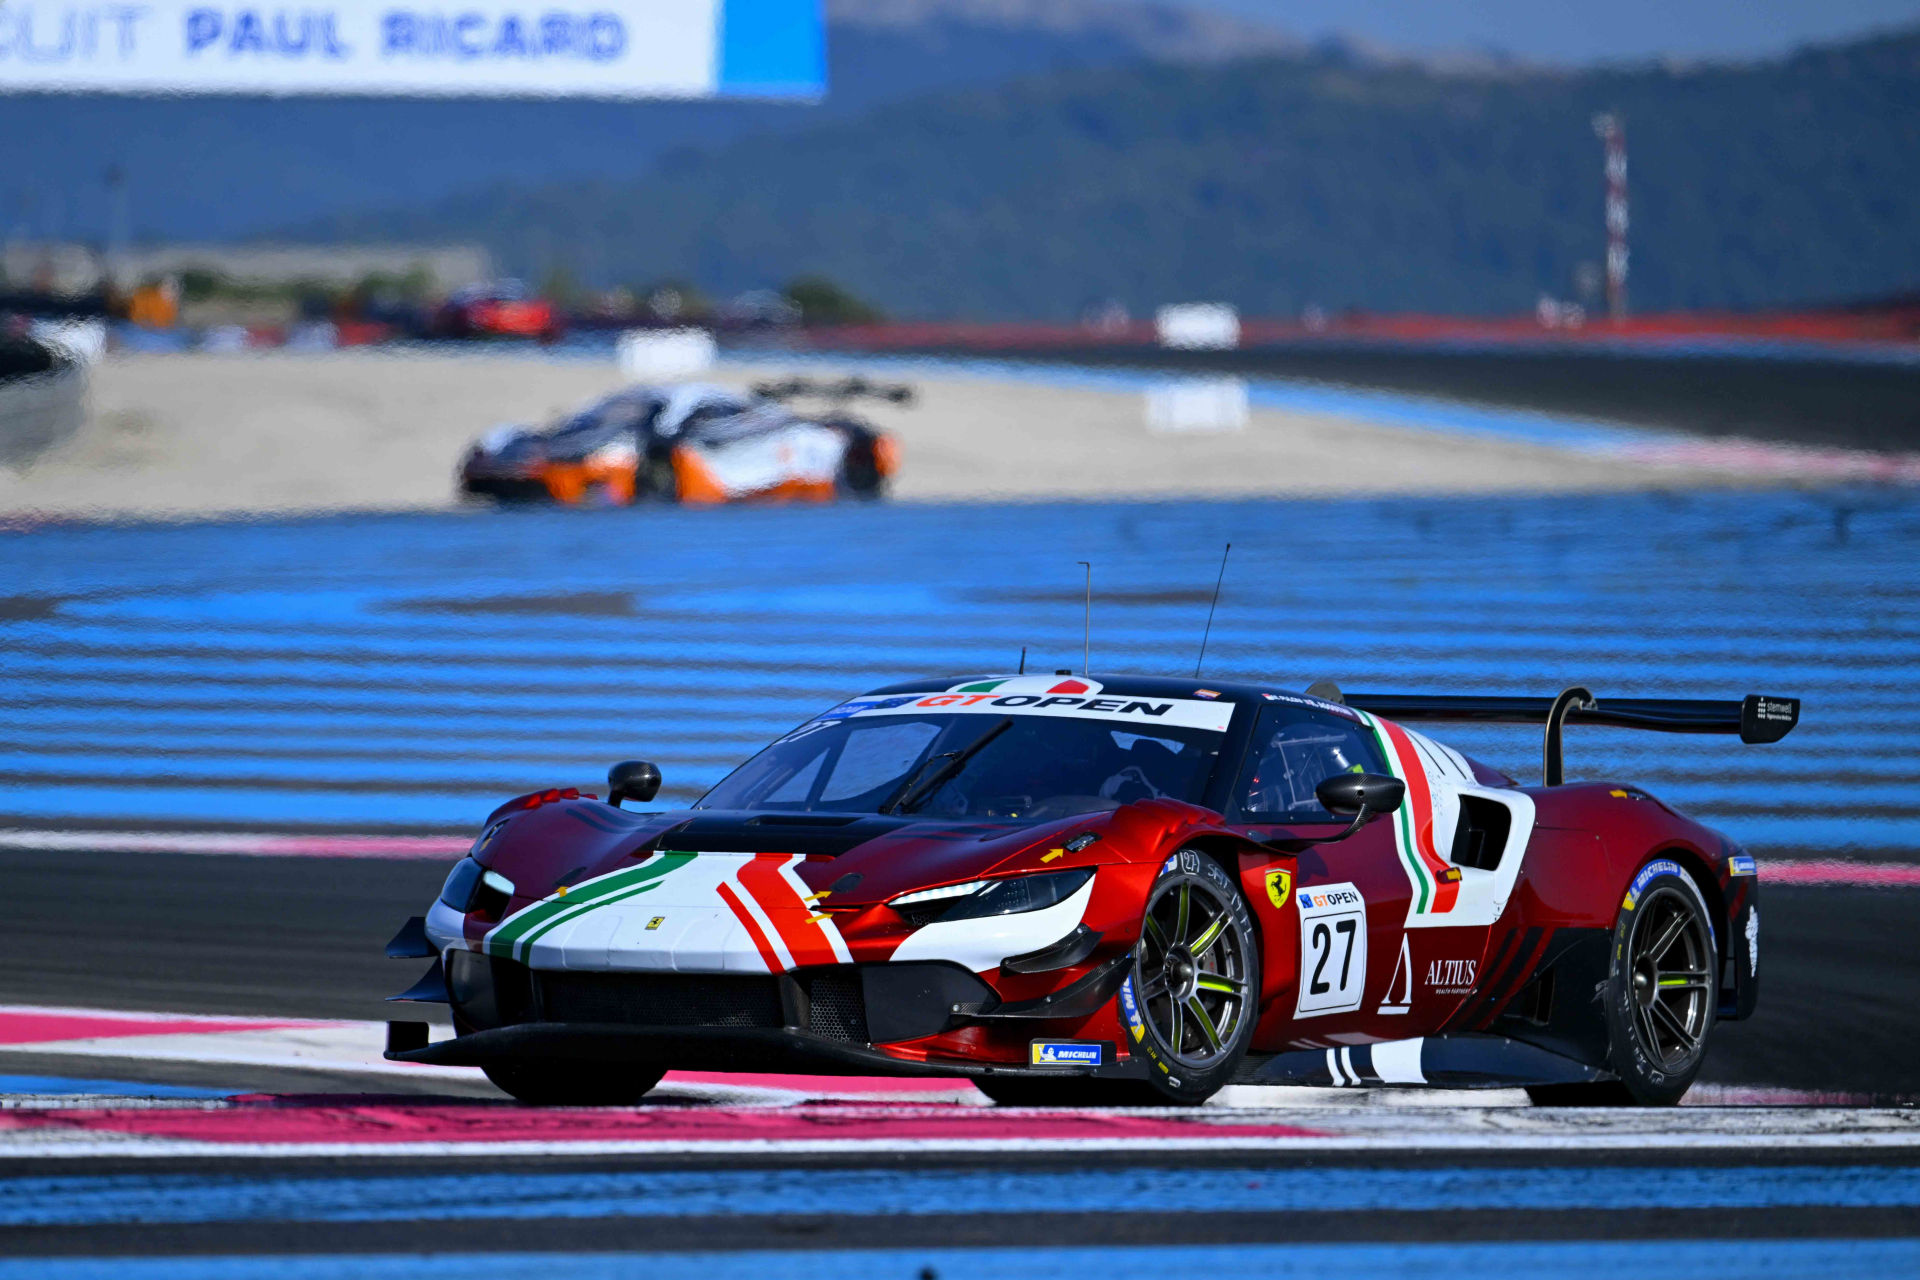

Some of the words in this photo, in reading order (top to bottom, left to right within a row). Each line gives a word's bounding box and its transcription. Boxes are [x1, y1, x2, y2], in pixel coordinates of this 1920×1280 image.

[184, 8, 350, 61] PAUL
[379, 9, 628, 64] RICARD
[1637, 863, 1678, 887] MICHELIN
[1310, 919, 1356, 995] 27
[1424, 960, 1477, 985] ALTIUS
[1058, 1050, 1097, 1059] MICHELIN
